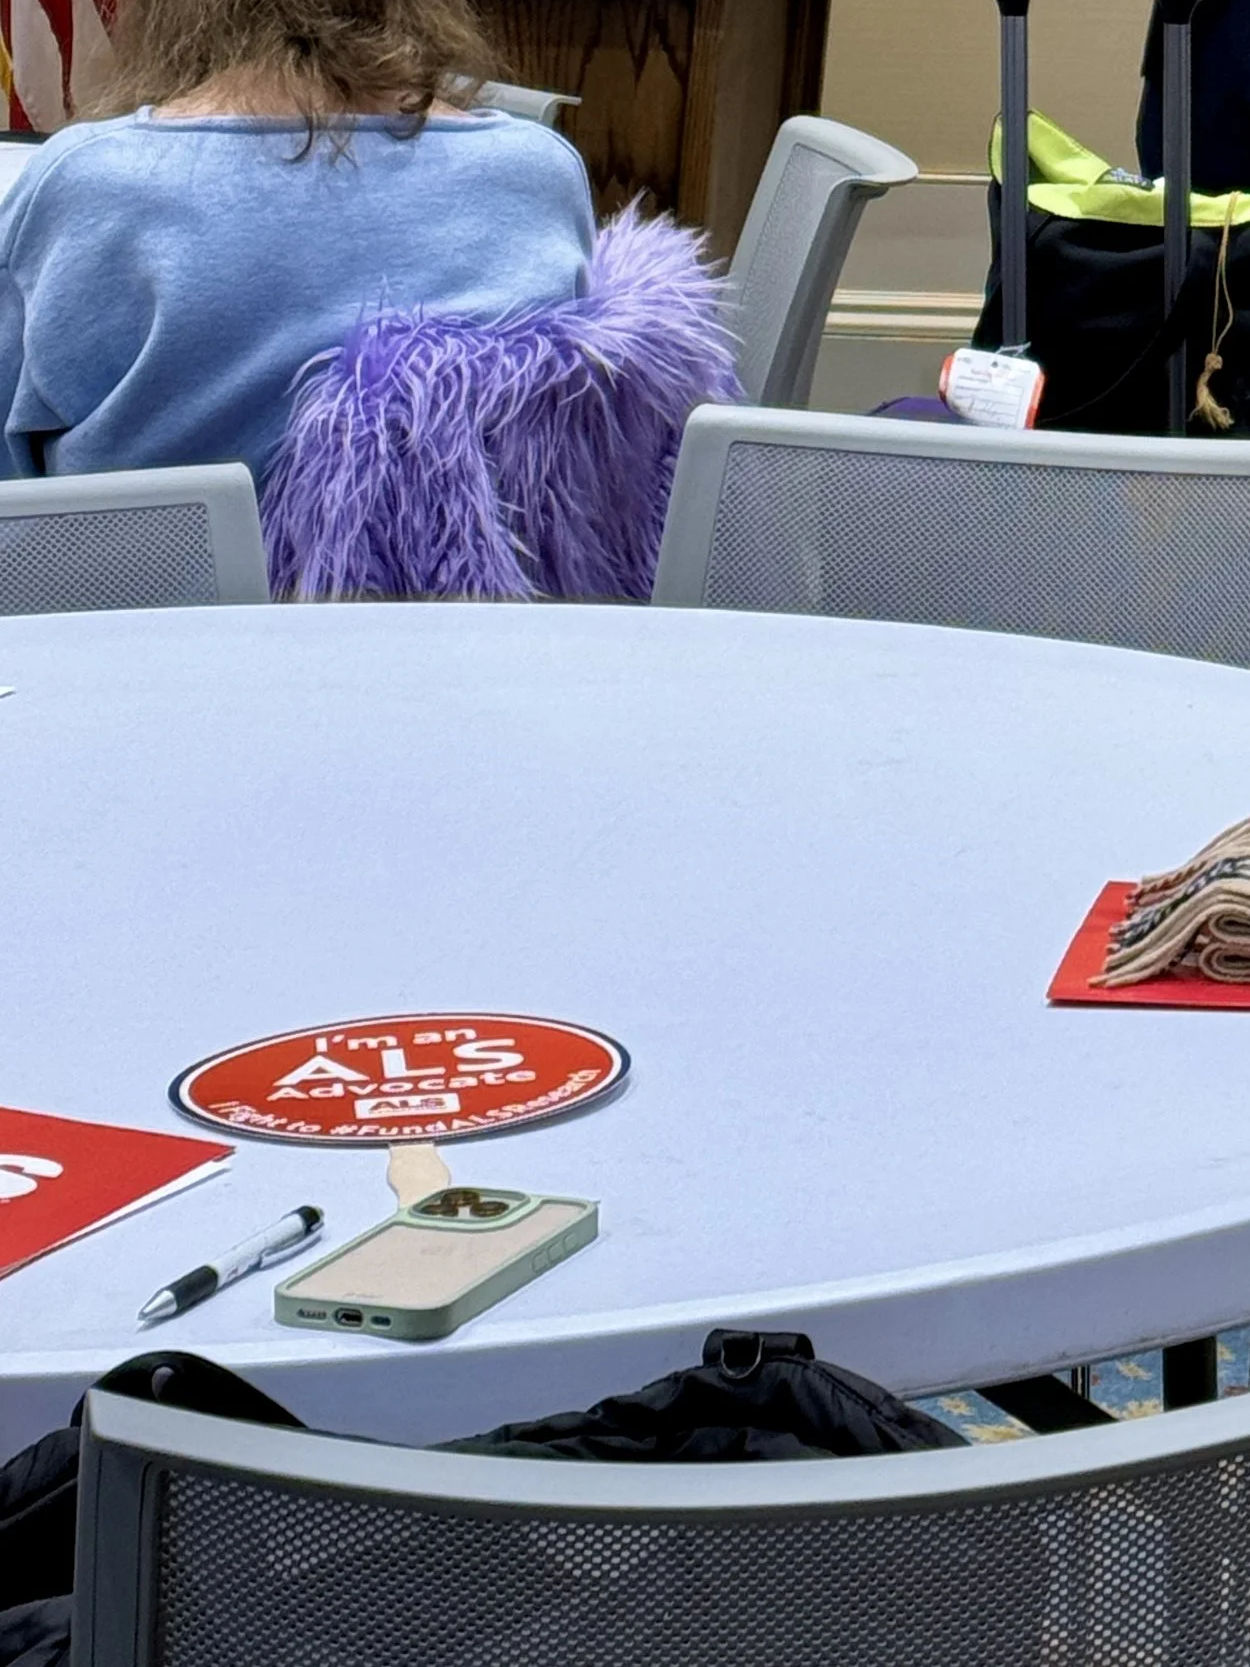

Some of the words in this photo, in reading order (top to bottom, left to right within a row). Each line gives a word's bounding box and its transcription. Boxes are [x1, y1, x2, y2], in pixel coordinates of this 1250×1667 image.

[413, 1027, 477, 1045] an
[272, 1038, 525, 1086] ALS
[266, 1069, 537, 1102] Advocate
